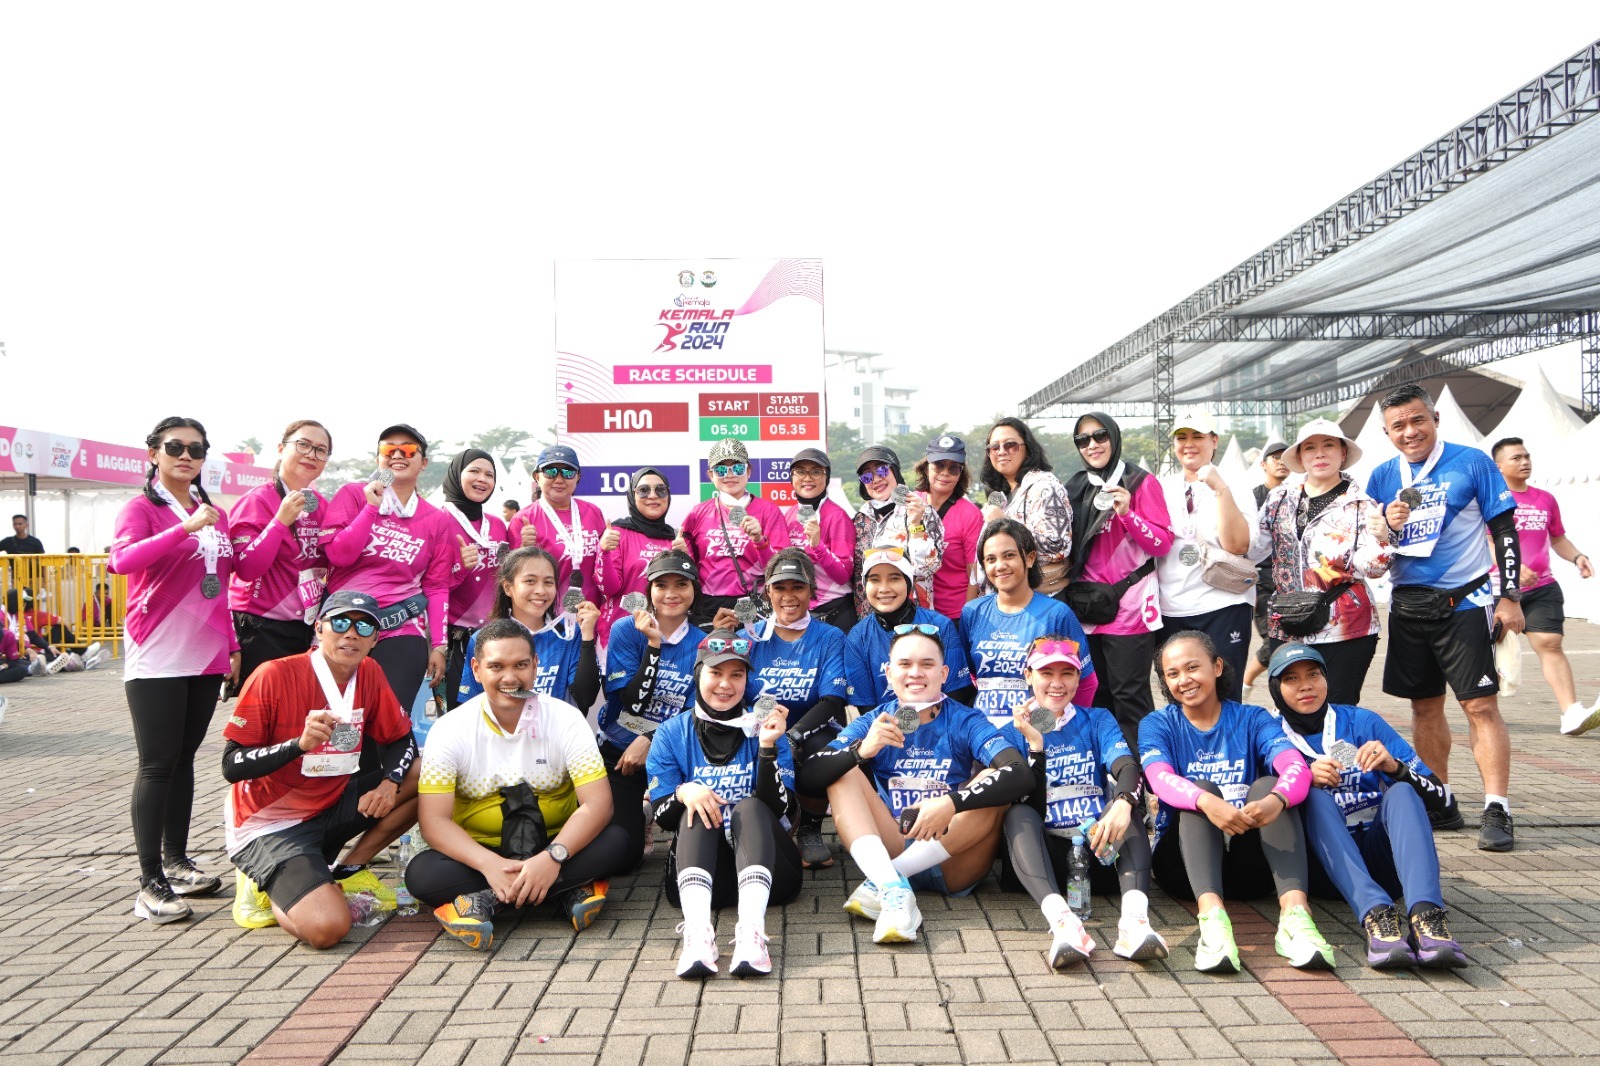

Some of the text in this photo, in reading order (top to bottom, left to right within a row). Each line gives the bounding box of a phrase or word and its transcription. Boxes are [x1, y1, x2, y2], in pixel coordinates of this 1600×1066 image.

[659, 309, 735, 320] KEMALA
[688, 322, 730, 333] RUN
[680, 335, 724, 349] 2024
[629, 368, 756, 381] RACE SCHEDULE
[708, 400, 750, 411] START
[770, 395, 805, 405] START
[766, 405, 808, 414] CLOSED
[603, 409, 652, 429] HM
[710, 424, 748, 435] 05.30
[769, 424, 806, 435] 05.35
[97, 454, 142, 473] BAGGAGE
[771, 461, 791, 470] STA
[600, 472, 632, 492] 10
[767, 471, 791, 480] CLO
[770, 490, 797, 501] 06.0
[1524, 522, 1546, 531] 2024
[371, 523, 425, 547] KEMALA
[388, 540, 421, 554] RUN
[379, 547, 416, 565] 2024
[1503, 537, 1517, 589] PAPUA
[759, 667, 817, 677] KEMALA
[993, 661, 1025, 675] 2024
[657, 670, 693, 684] MALA
[781, 677, 815, 687] RUN
[775, 688, 810, 701] 2024
[893, 759, 952, 770] KEMALA
[1046, 751, 1094, 768] EMALA
[1187, 759, 1245, 773] KEMALA
[694, 762, 753, 777] KEMALA
[917, 770, 949, 780] RUN
[1062, 761, 1096, 779] RUN
[719, 775, 752, 788] RUN
[1210, 771, 1243, 784] RUN
